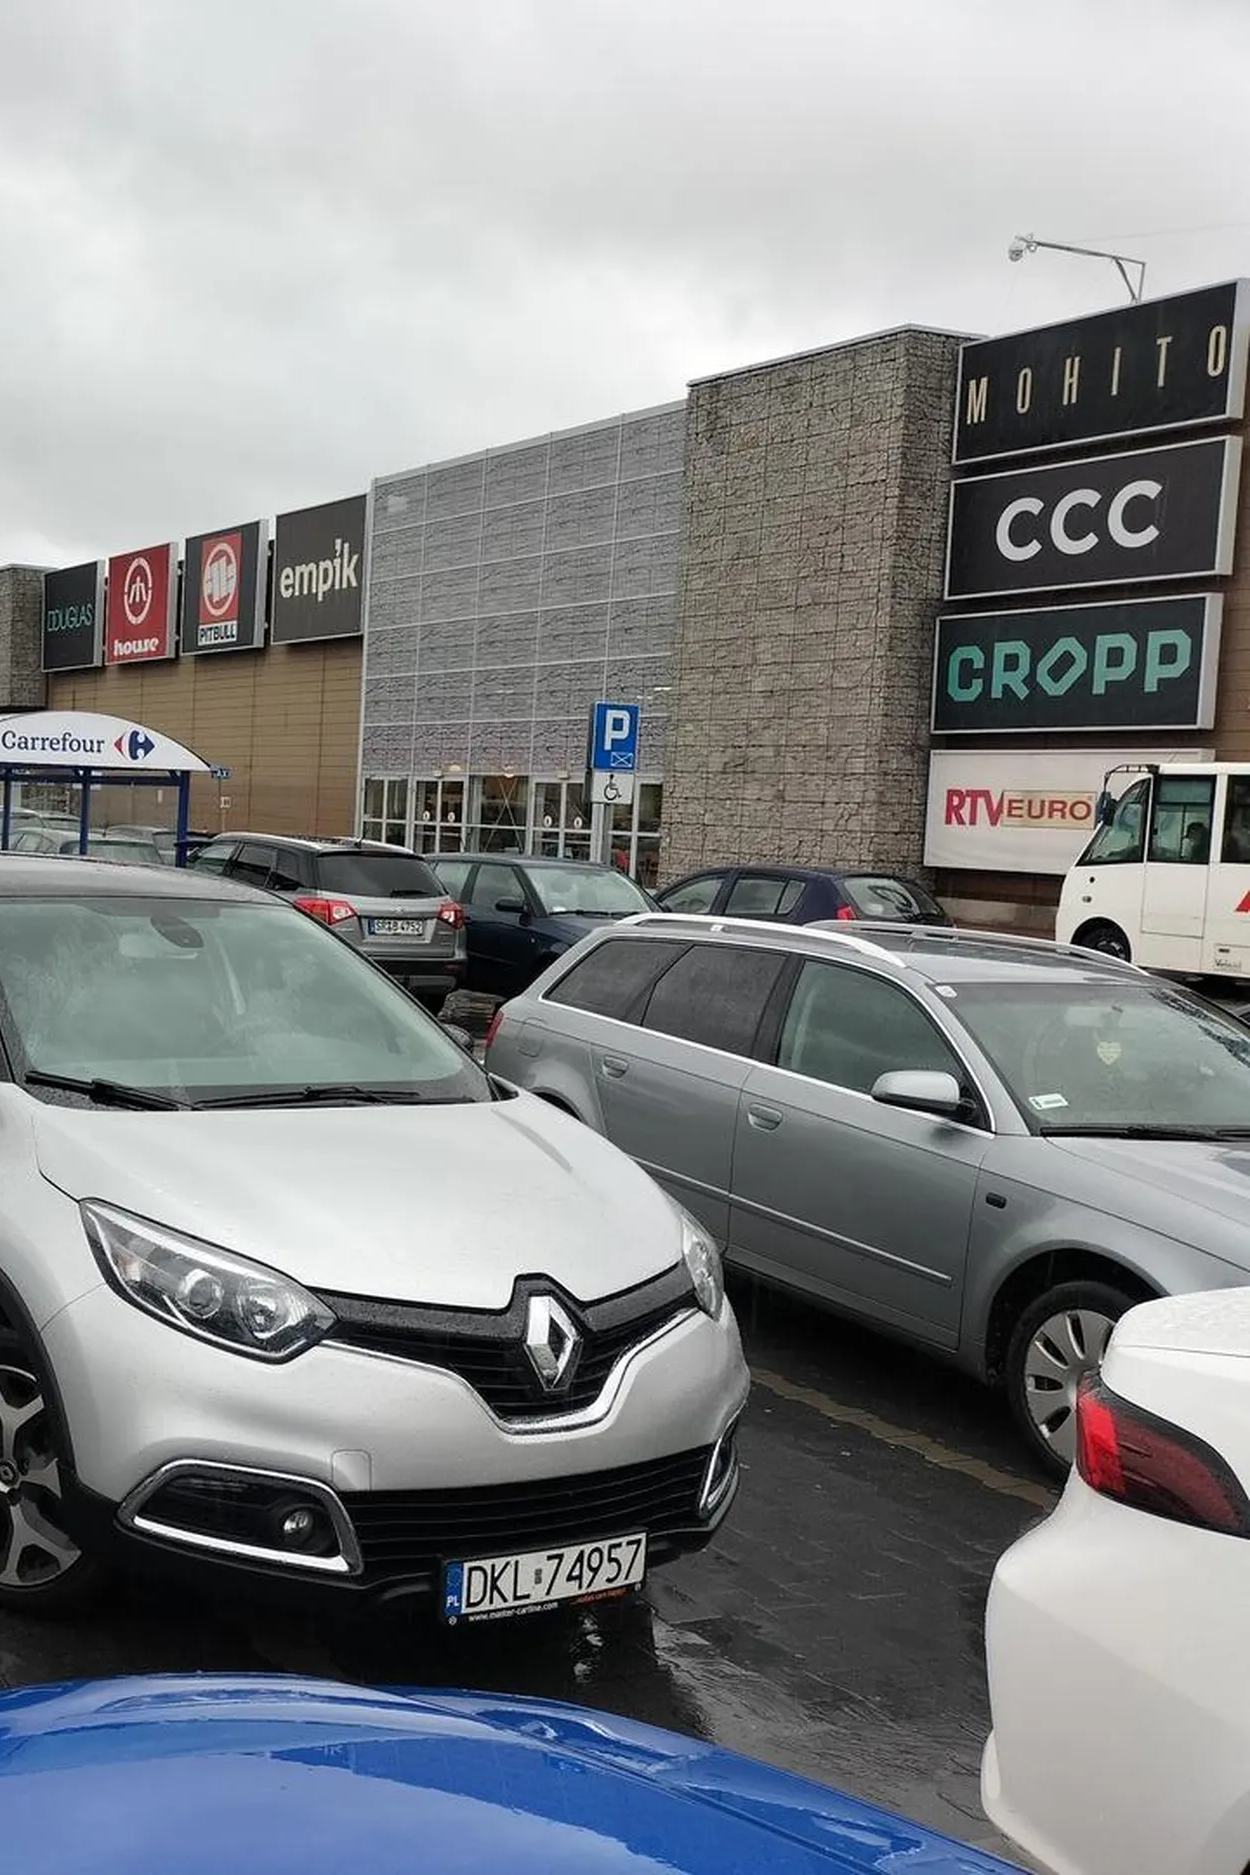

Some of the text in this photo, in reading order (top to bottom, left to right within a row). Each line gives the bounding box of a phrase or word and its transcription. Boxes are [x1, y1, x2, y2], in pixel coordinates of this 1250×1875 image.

[965, 324, 1228, 425] MOHITO
[996, 479, 1163, 562] CCC
[279, 538, 359, 603] empik
[47, 603, 93, 632] DOUGLAS
[199, 623, 237, 643] PITBULL
[112, 637, 159, 657] house
[946, 628, 1193, 703] CROPP
[0, 729, 105, 753] Carrefour
[603, 709, 631, 752] P
[1006, 798, 1092, 821] EURO
[465, 1540, 642, 1608] DKL 74957
[446, 1594, 461, 1608] PL
